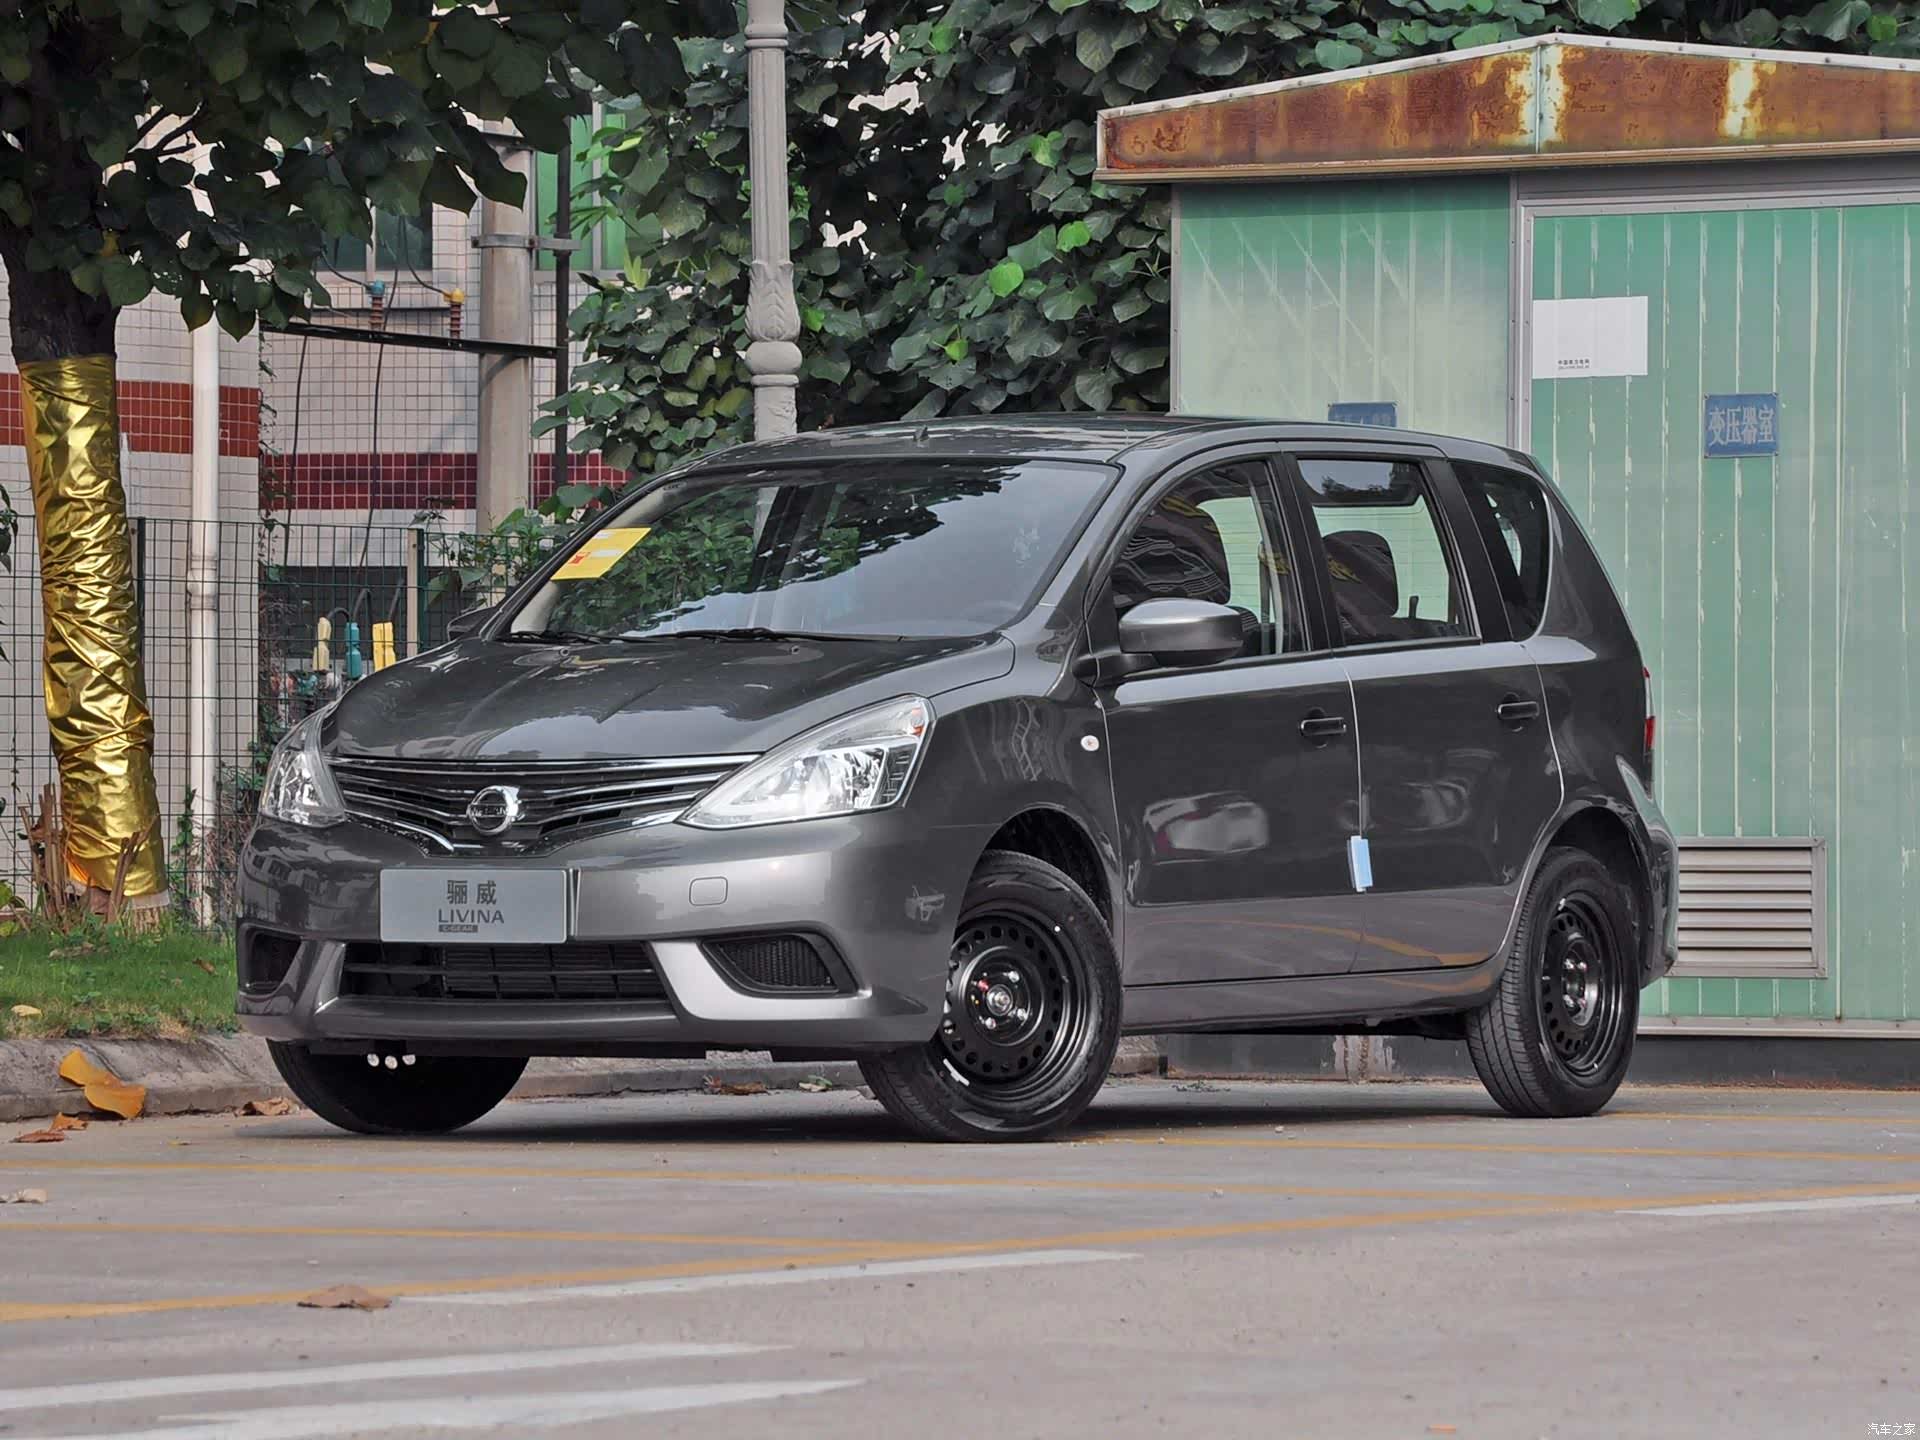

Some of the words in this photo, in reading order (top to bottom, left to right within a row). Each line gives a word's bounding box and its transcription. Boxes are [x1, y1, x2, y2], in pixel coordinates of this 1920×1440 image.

[1708, 404, 1775, 446] 变压器室
[447, 880, 497, 905] 骊威
[438, 908, 504, 924] LIVINA
